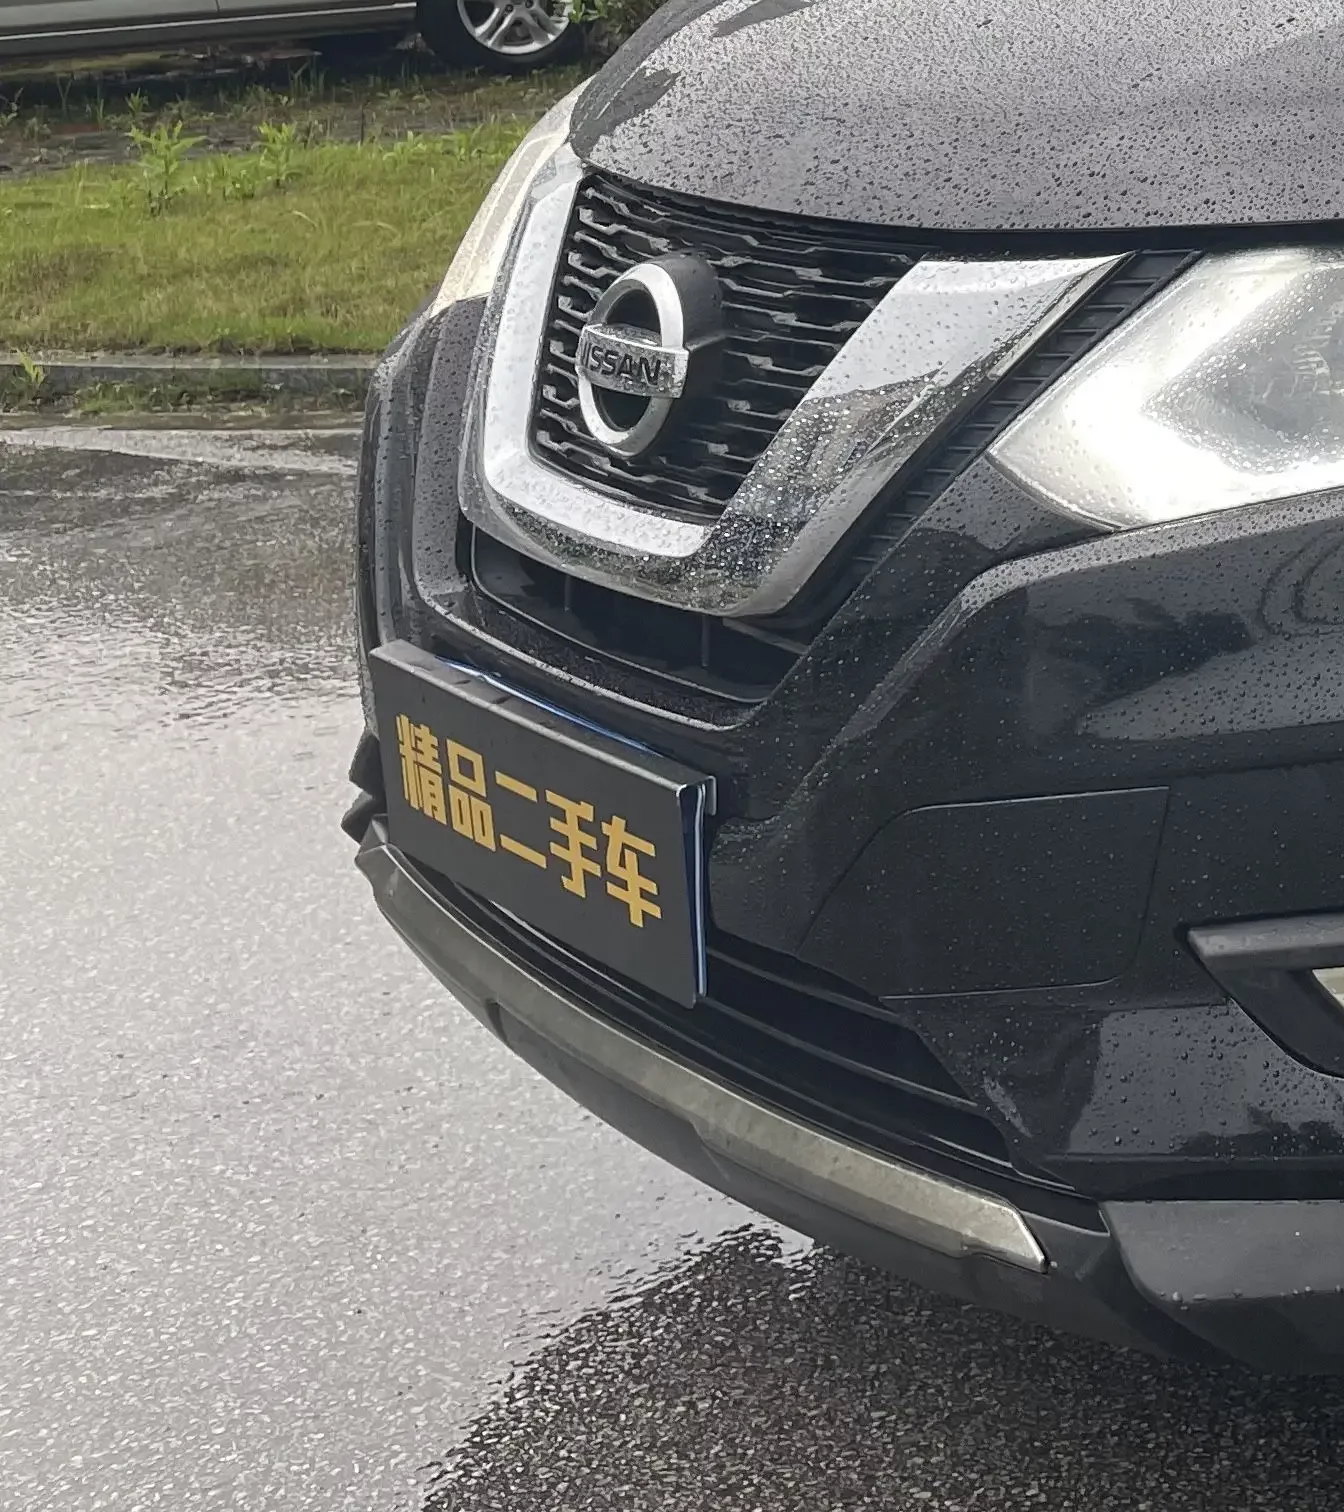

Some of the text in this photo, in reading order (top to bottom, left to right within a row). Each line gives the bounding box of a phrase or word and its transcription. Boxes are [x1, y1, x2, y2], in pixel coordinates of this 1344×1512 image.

[396, 713, 662, 927] 精品二手车
